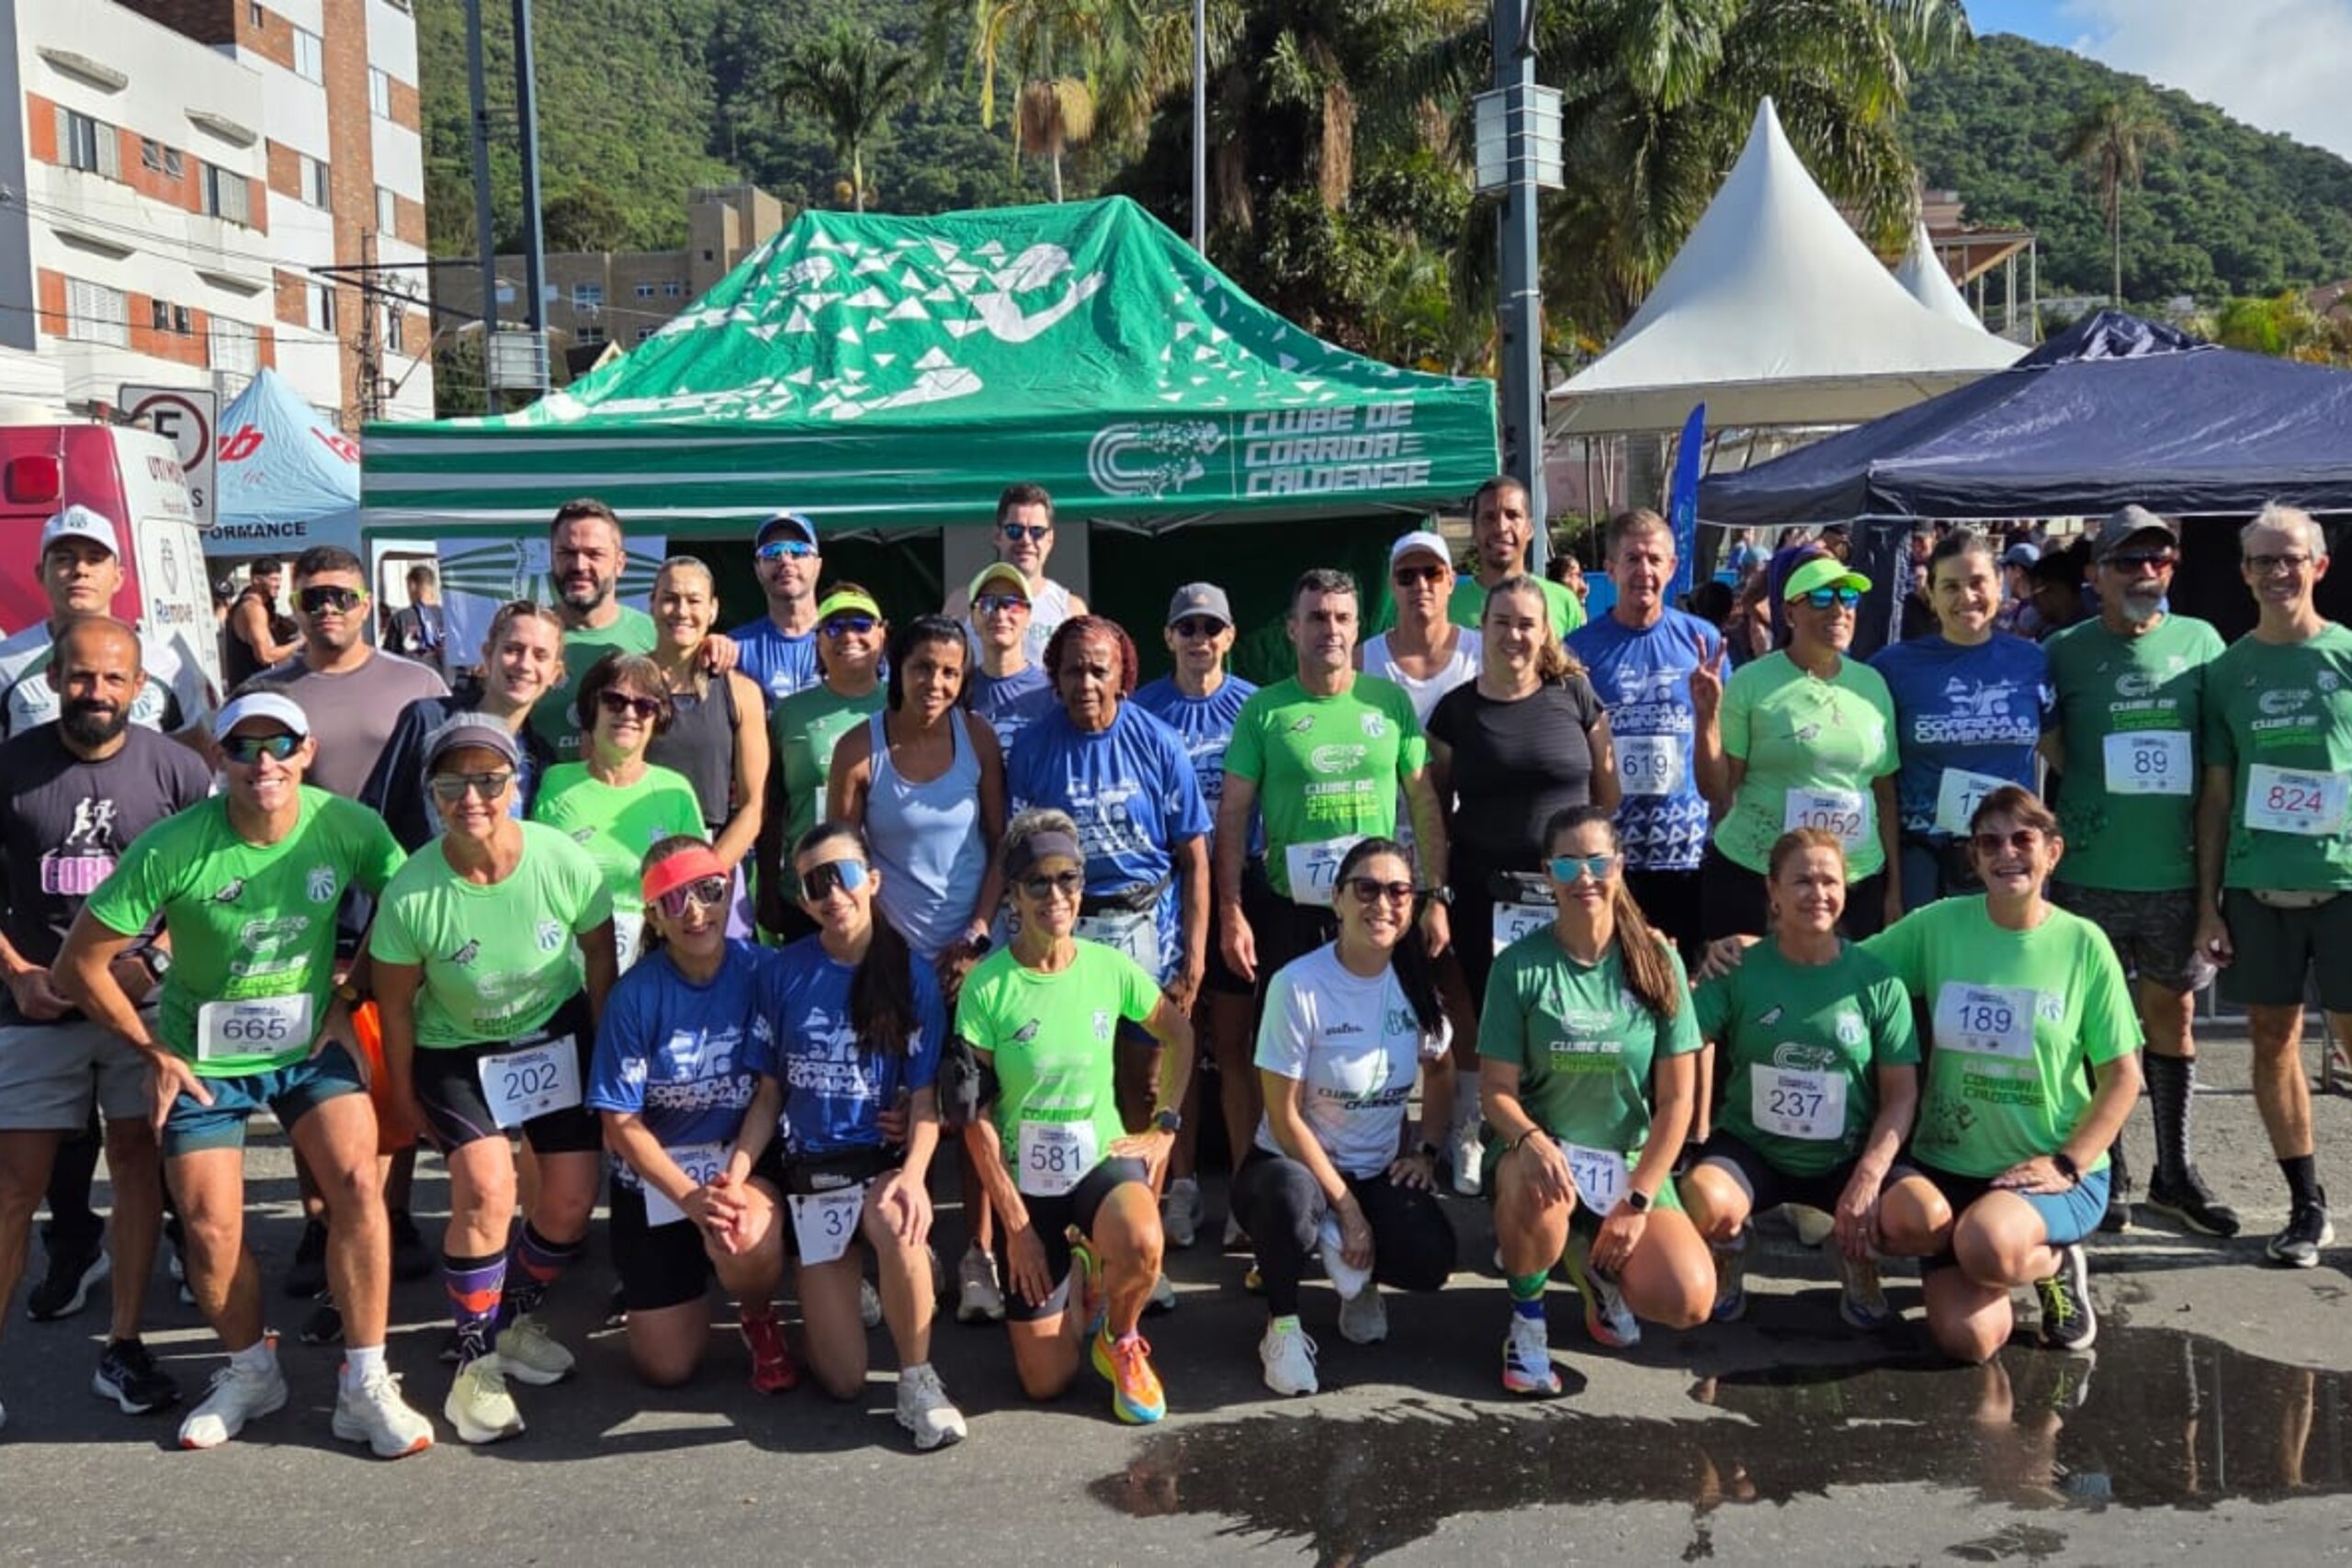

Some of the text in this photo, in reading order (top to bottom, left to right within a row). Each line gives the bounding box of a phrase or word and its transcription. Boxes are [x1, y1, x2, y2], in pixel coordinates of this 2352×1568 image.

[1244, 400, 1415, 438] CLUBE DE
[1245, 434, 1401, 468] CORRIDA
[1246, 460, 1432, 498] CALDENSE
[1623, 754, 1668, 776] 619
[2134, 750, 2168, 773] 89
[2267, 785, 2323, 814] 824
[222, 1018, 288, 1041] 665
[1959, 1004, 2012, 1033] 189
[503, 1062, 560, 1100] 202
[1770, 1089, 1823, 1118] 237
[1030, 1144, 1080, 1172] 581
